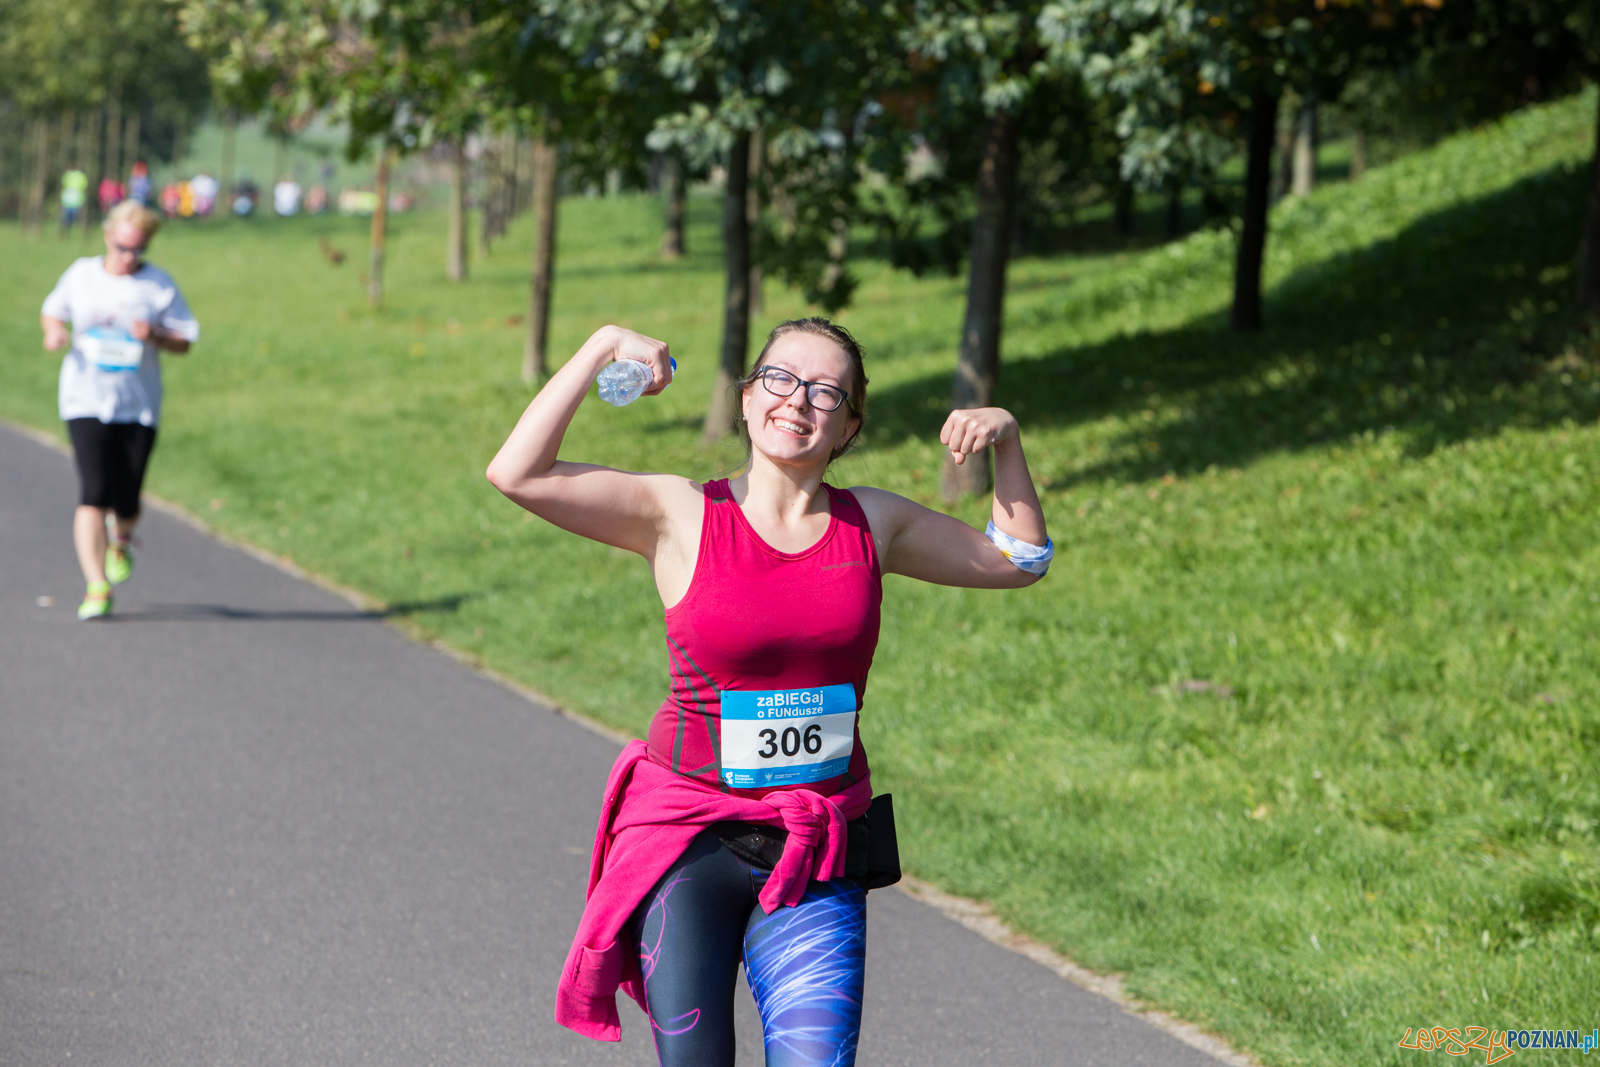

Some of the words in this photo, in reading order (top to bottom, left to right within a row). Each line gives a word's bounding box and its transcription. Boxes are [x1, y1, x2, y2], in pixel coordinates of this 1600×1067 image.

[756, 690, 824, 707] zaBIEGaj
[757, 710, 765, 719] o
[767, 706, 824, 718] FUNdusze
[758, 724, 822, 759] 306
